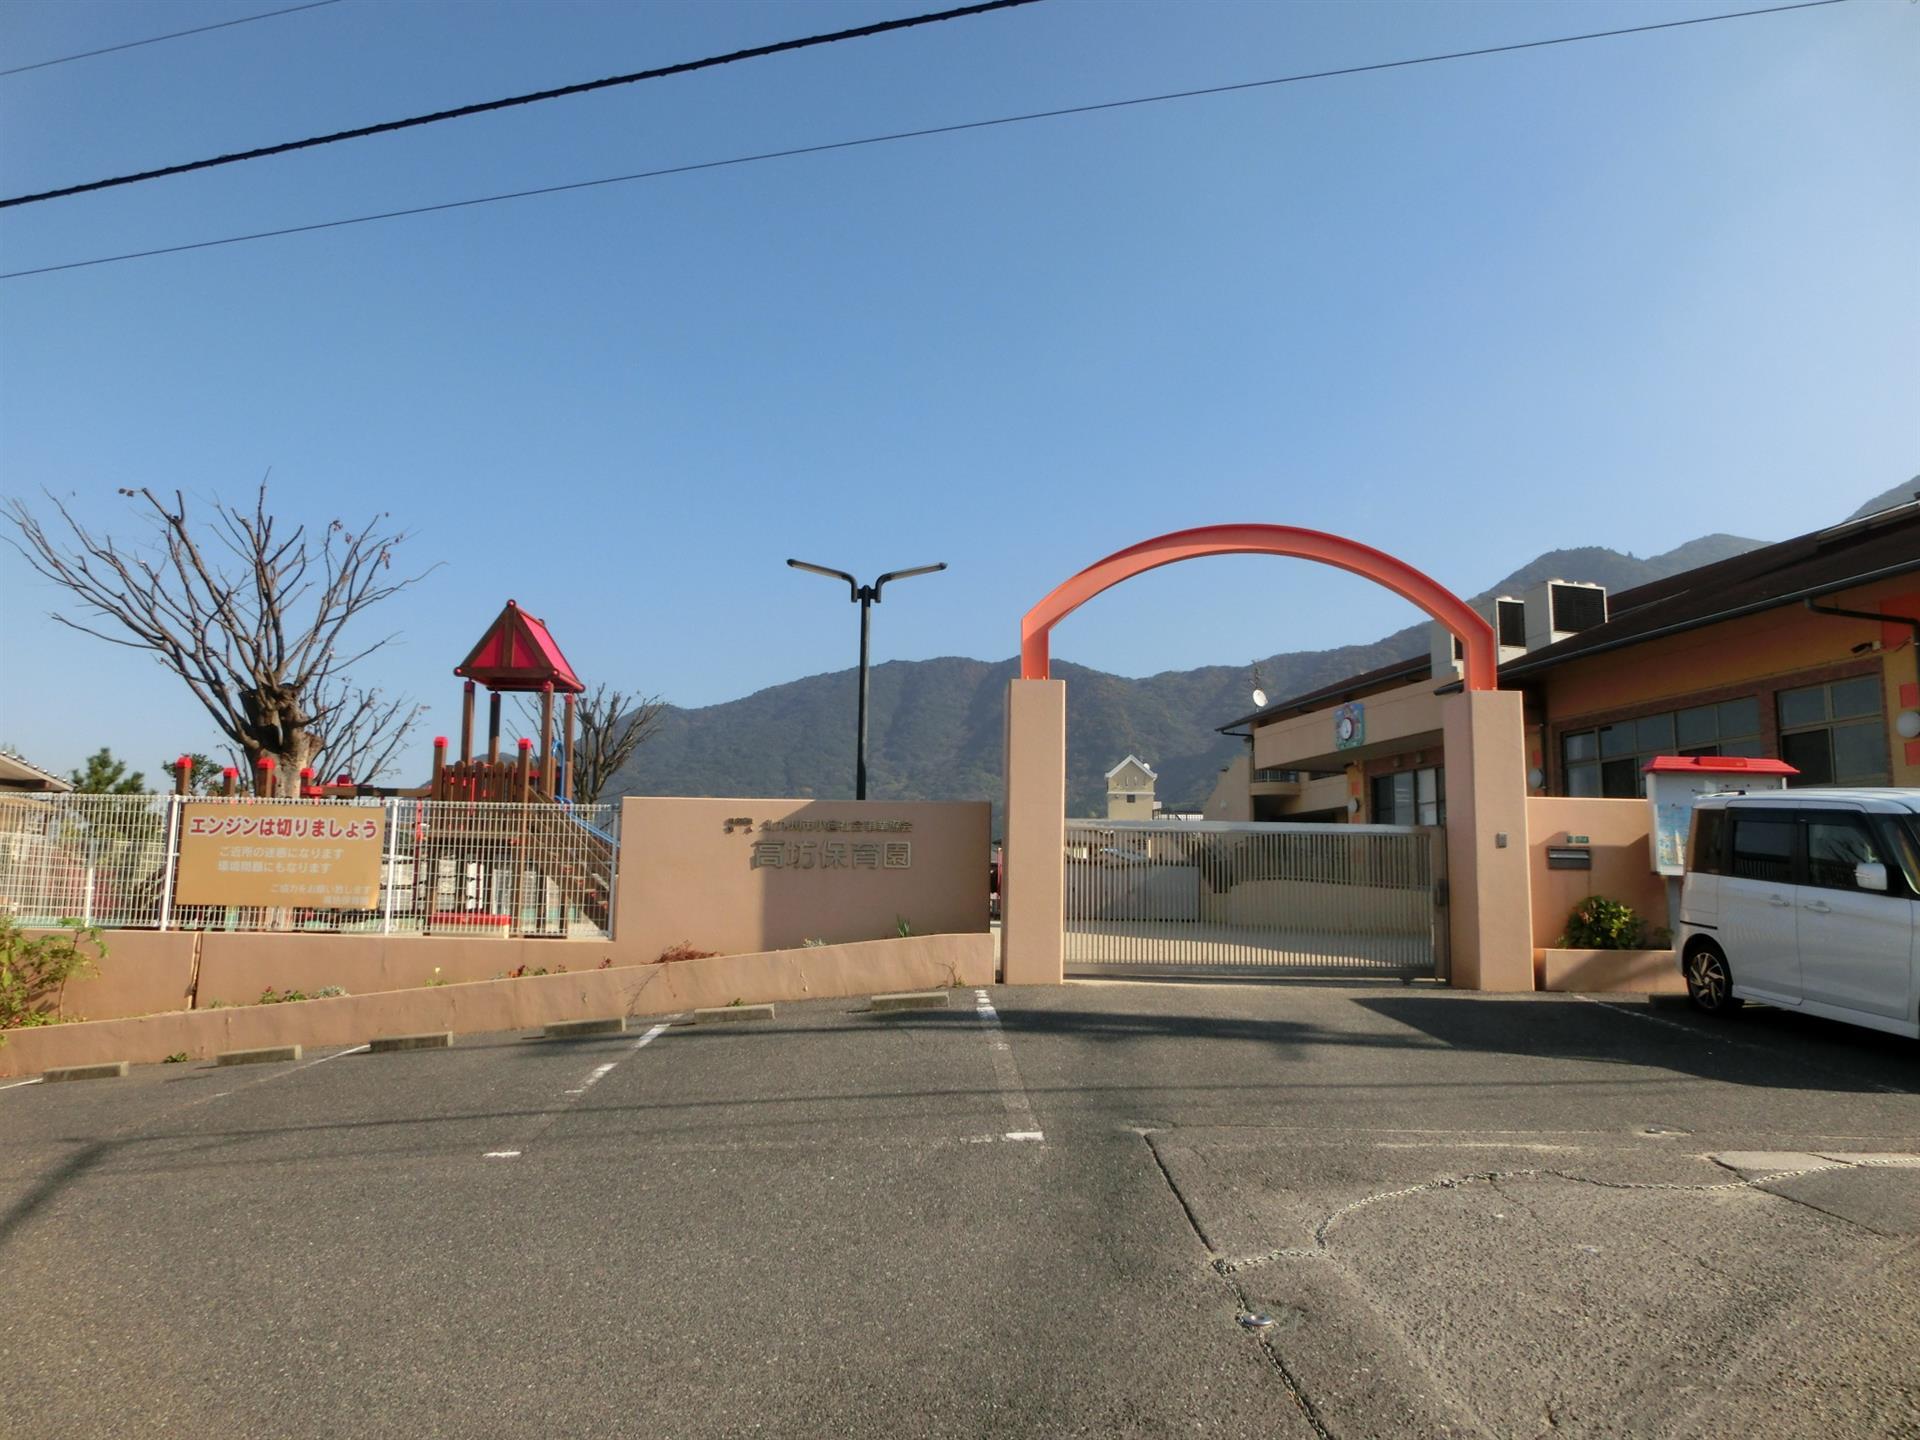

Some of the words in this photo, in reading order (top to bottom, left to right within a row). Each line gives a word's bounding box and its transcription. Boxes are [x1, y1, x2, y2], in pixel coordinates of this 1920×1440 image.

[190, 818, 377, 838] エンジンは切りましょう
[753, 840, 912, 869] 高坊保育園
